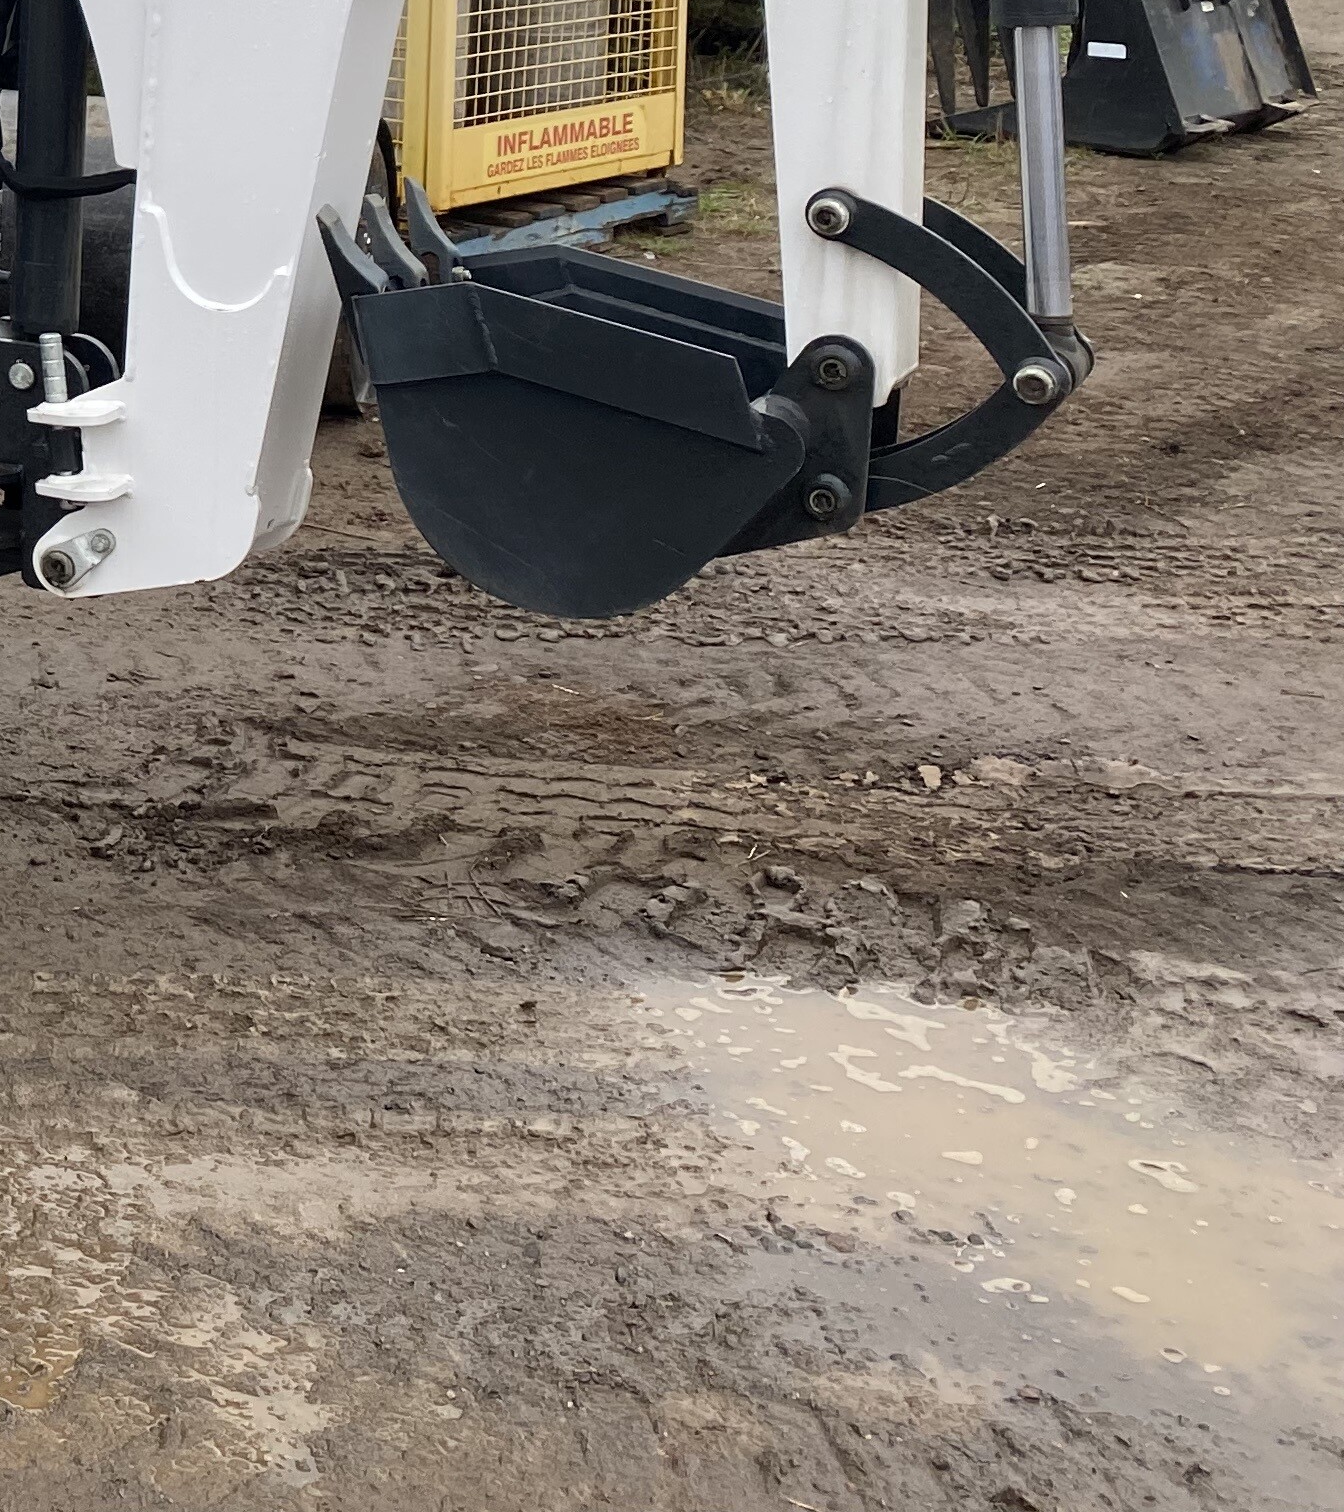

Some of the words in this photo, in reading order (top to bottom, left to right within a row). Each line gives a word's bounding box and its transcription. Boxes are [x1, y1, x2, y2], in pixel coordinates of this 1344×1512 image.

[497, 112, 634, 157] INFLAMMABLE
[487, 157, 524, 178] GARDEZ
[526, 154, 543, 170] LES
[546, 146, 588, 167] FLAMMES
